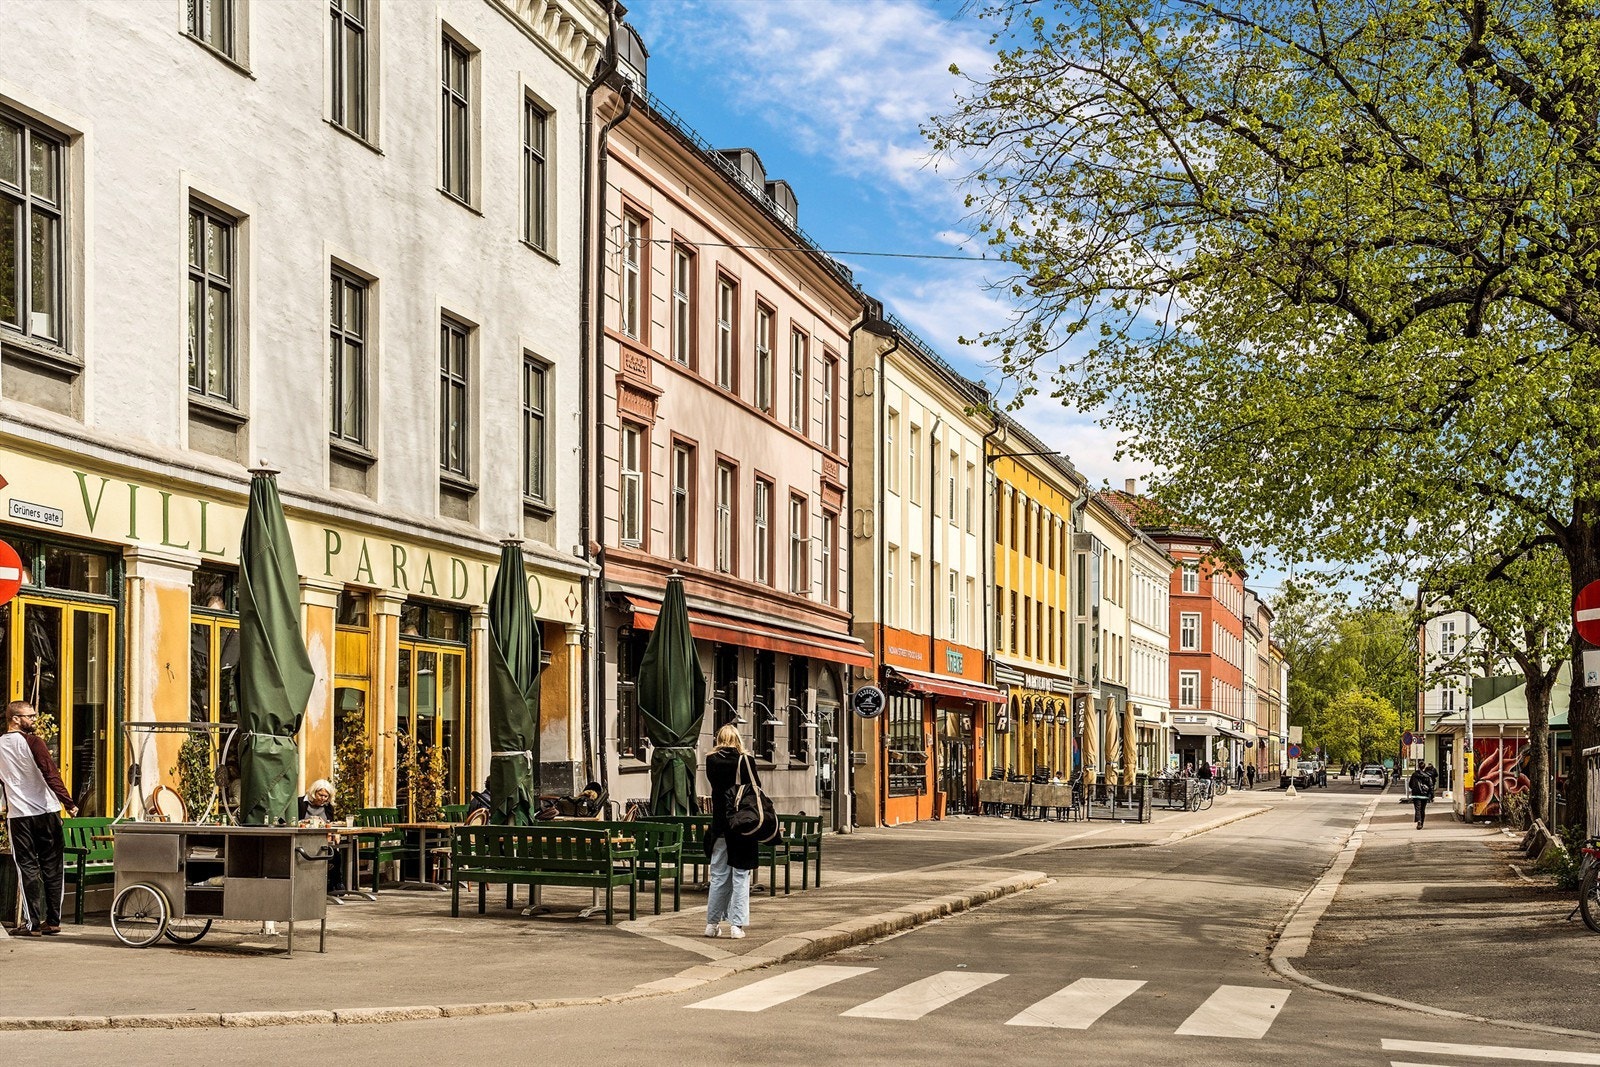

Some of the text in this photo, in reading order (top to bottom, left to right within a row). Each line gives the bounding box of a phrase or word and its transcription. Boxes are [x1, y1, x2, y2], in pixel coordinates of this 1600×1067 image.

[13, 503, 59, 522] Grüners gate
[73, 471, 542, 614] VILL PARADIO
